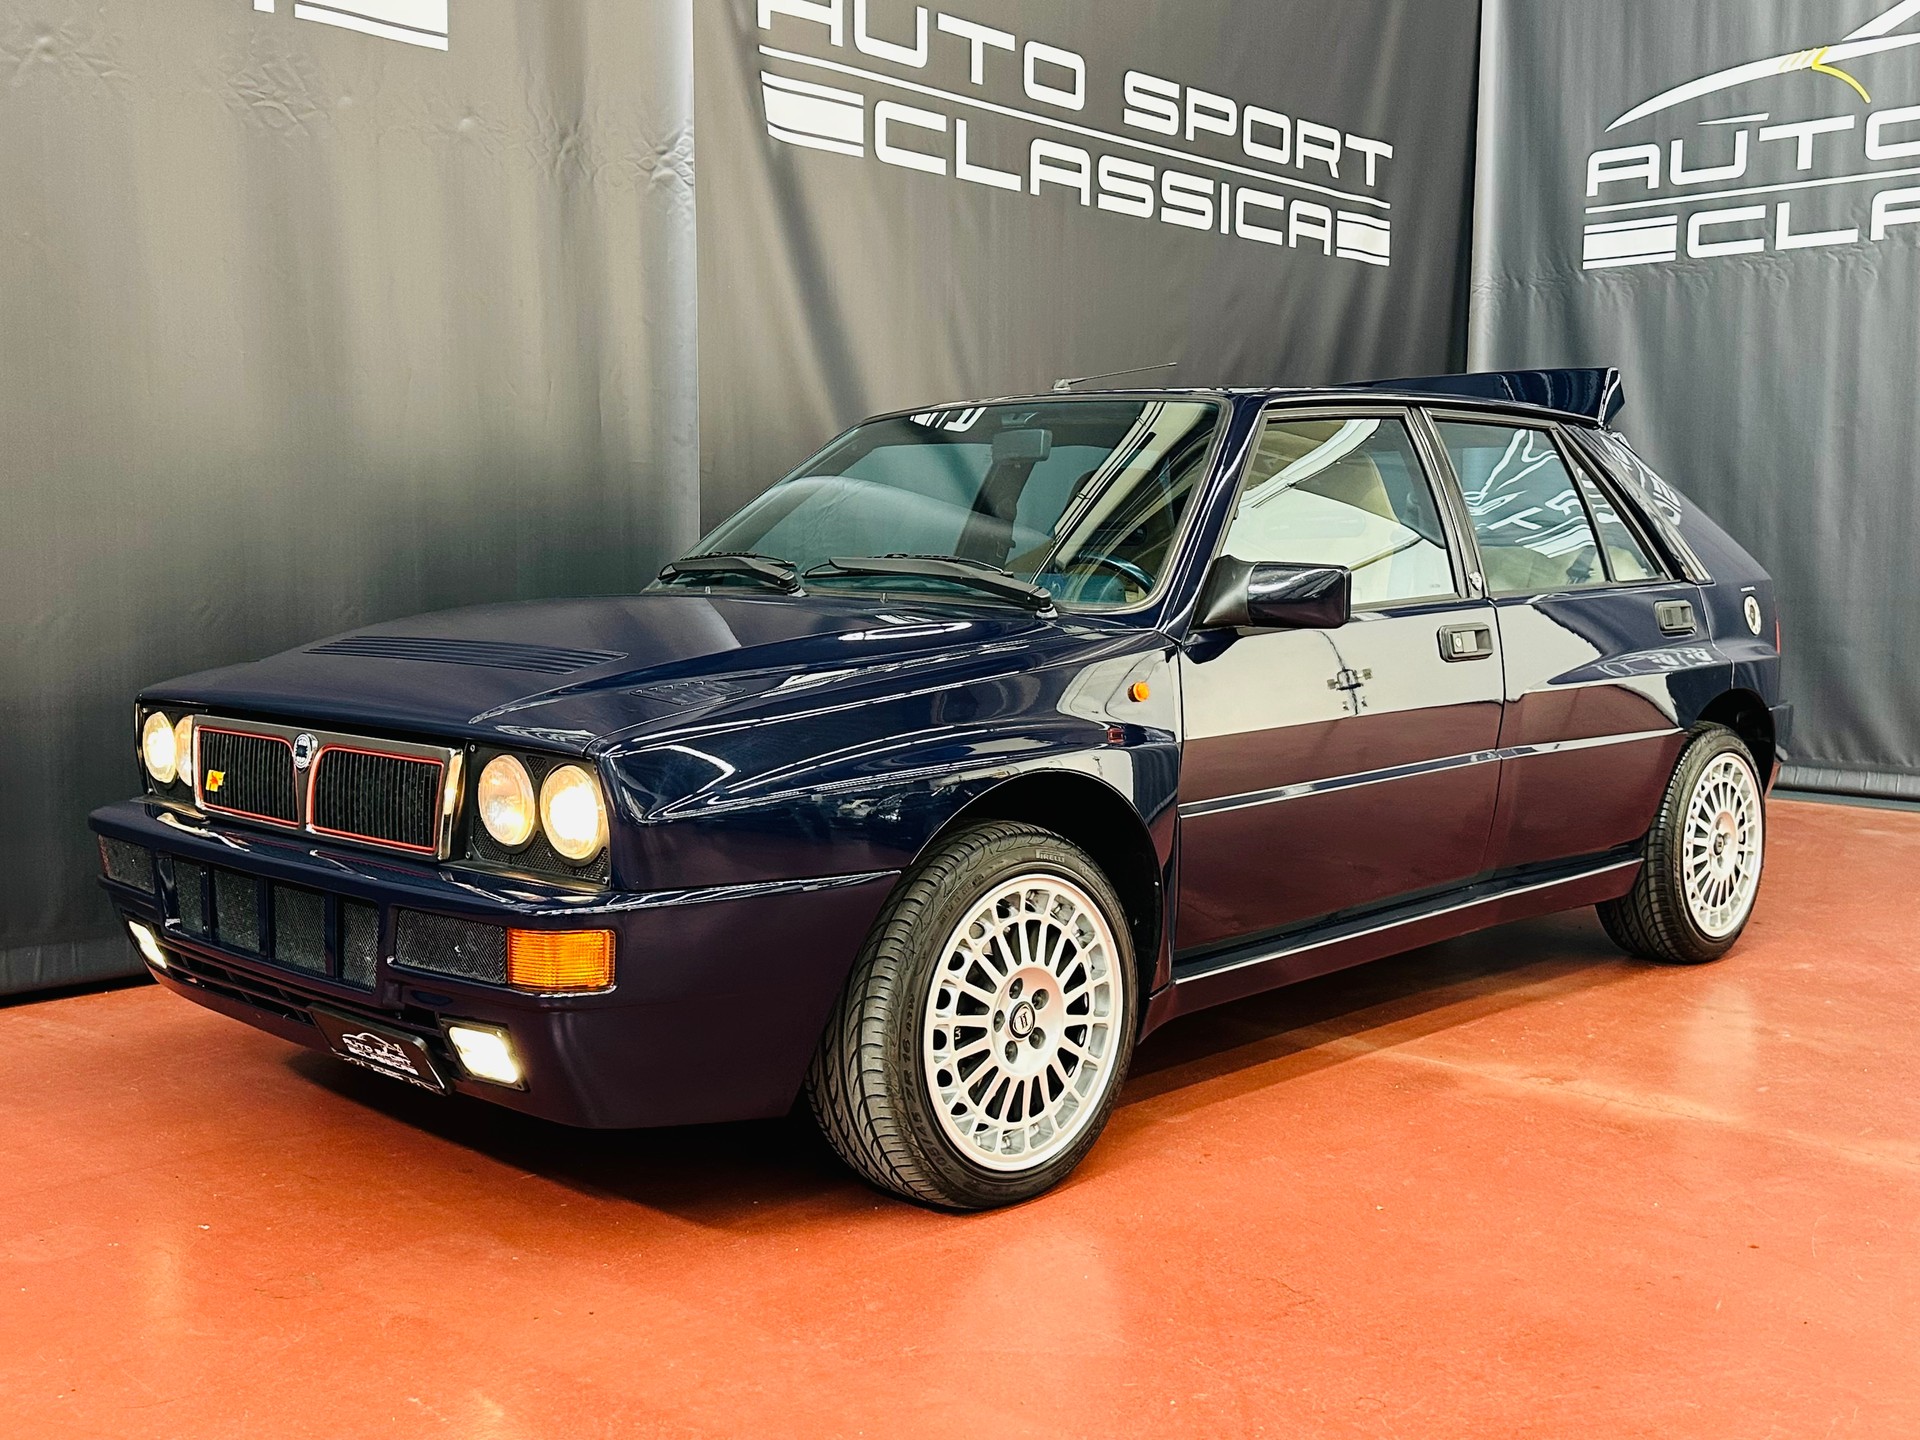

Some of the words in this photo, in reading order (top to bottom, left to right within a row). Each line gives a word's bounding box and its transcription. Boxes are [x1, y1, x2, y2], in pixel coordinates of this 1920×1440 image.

[757, 0, 1085, 111] AUTO
[1123, 70, 1393, 187] SPORT
[1586, 105, 1920, 197] AUTO
[874, 100, 1332, 256] CLASSICA
